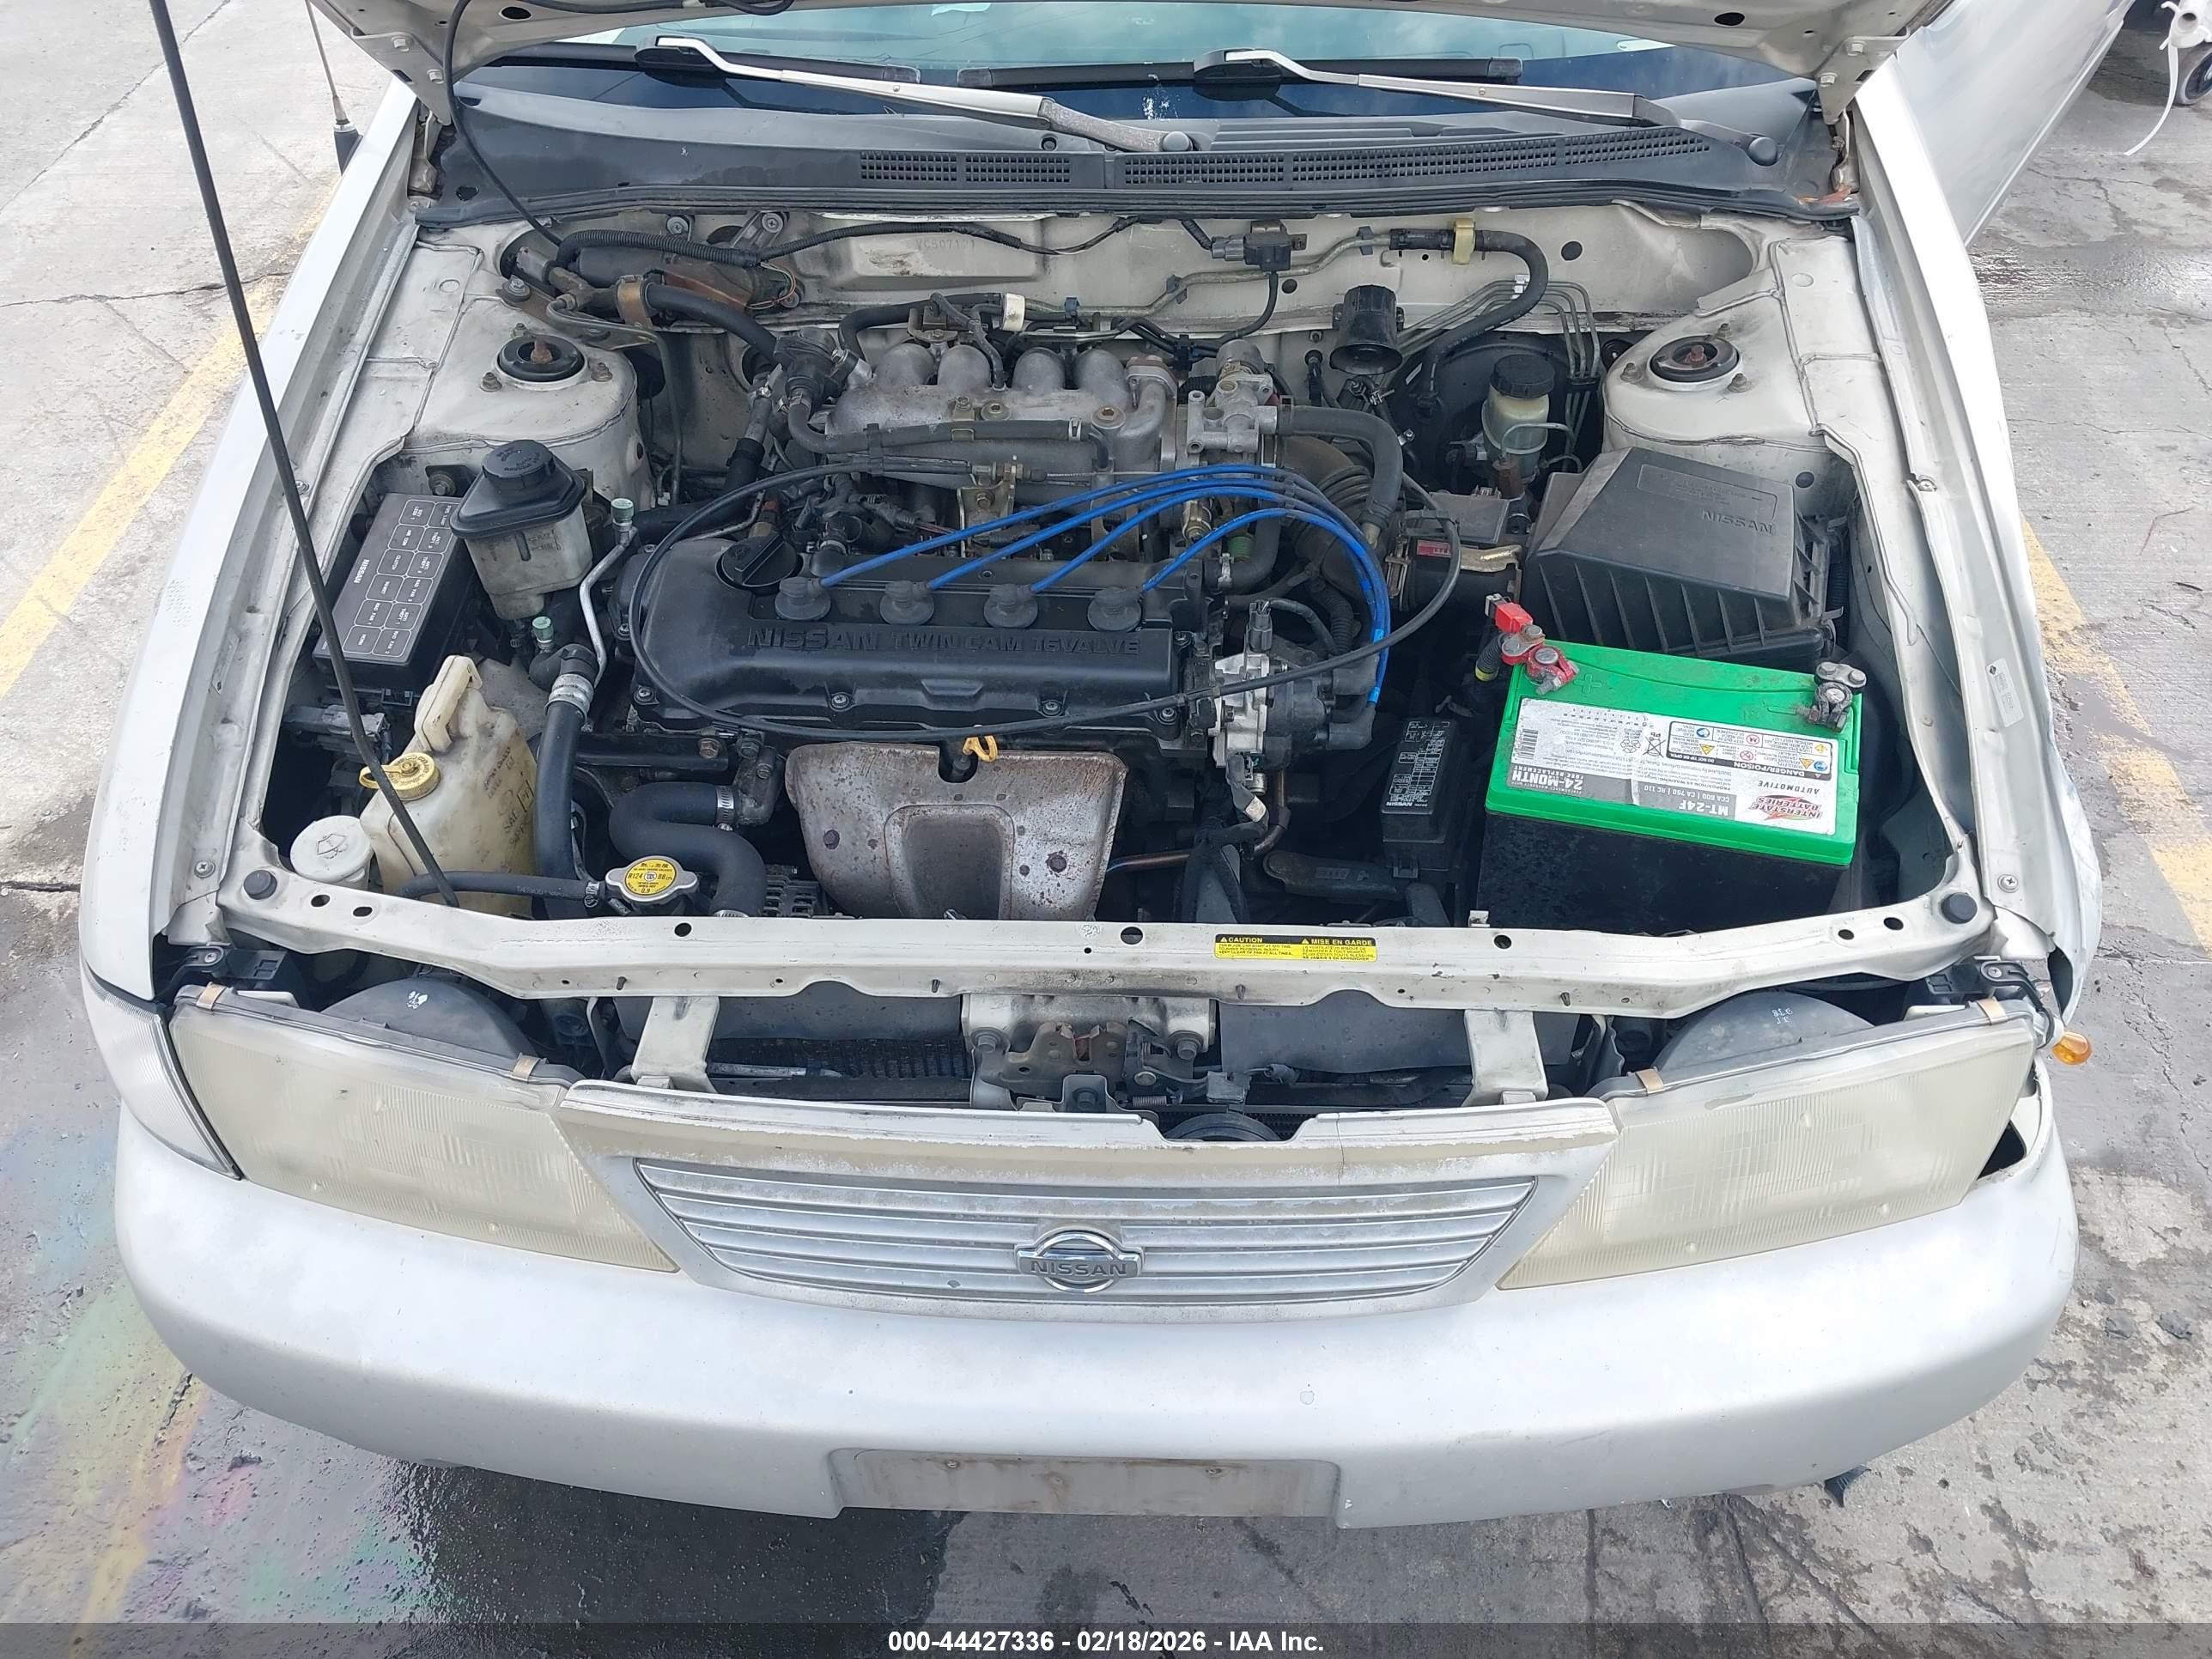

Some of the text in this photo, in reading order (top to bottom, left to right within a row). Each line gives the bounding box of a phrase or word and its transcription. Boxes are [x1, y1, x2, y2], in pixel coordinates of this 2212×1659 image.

[1702, 508, 1774, 536] NISSAN
[353, 558, 370, 584] NISSAN
[747, 626, 1141, 655] NISSAN TWIN CAM 16VALVE
[1732, 761, 1806, 777] DANGER/POISON
[1511, 769, 1583, 791] 24-MONTH
[1757, 780, 1820, 795] AUTOMOTIVE
[1677, 799, 1729, 817] MT-24F
[1751, 803, 1820, 818] INTERSTATE
[1757, 797, 1819, 811] BATTERIES
[1030, 1261, 1127, 1277] NISSAN
